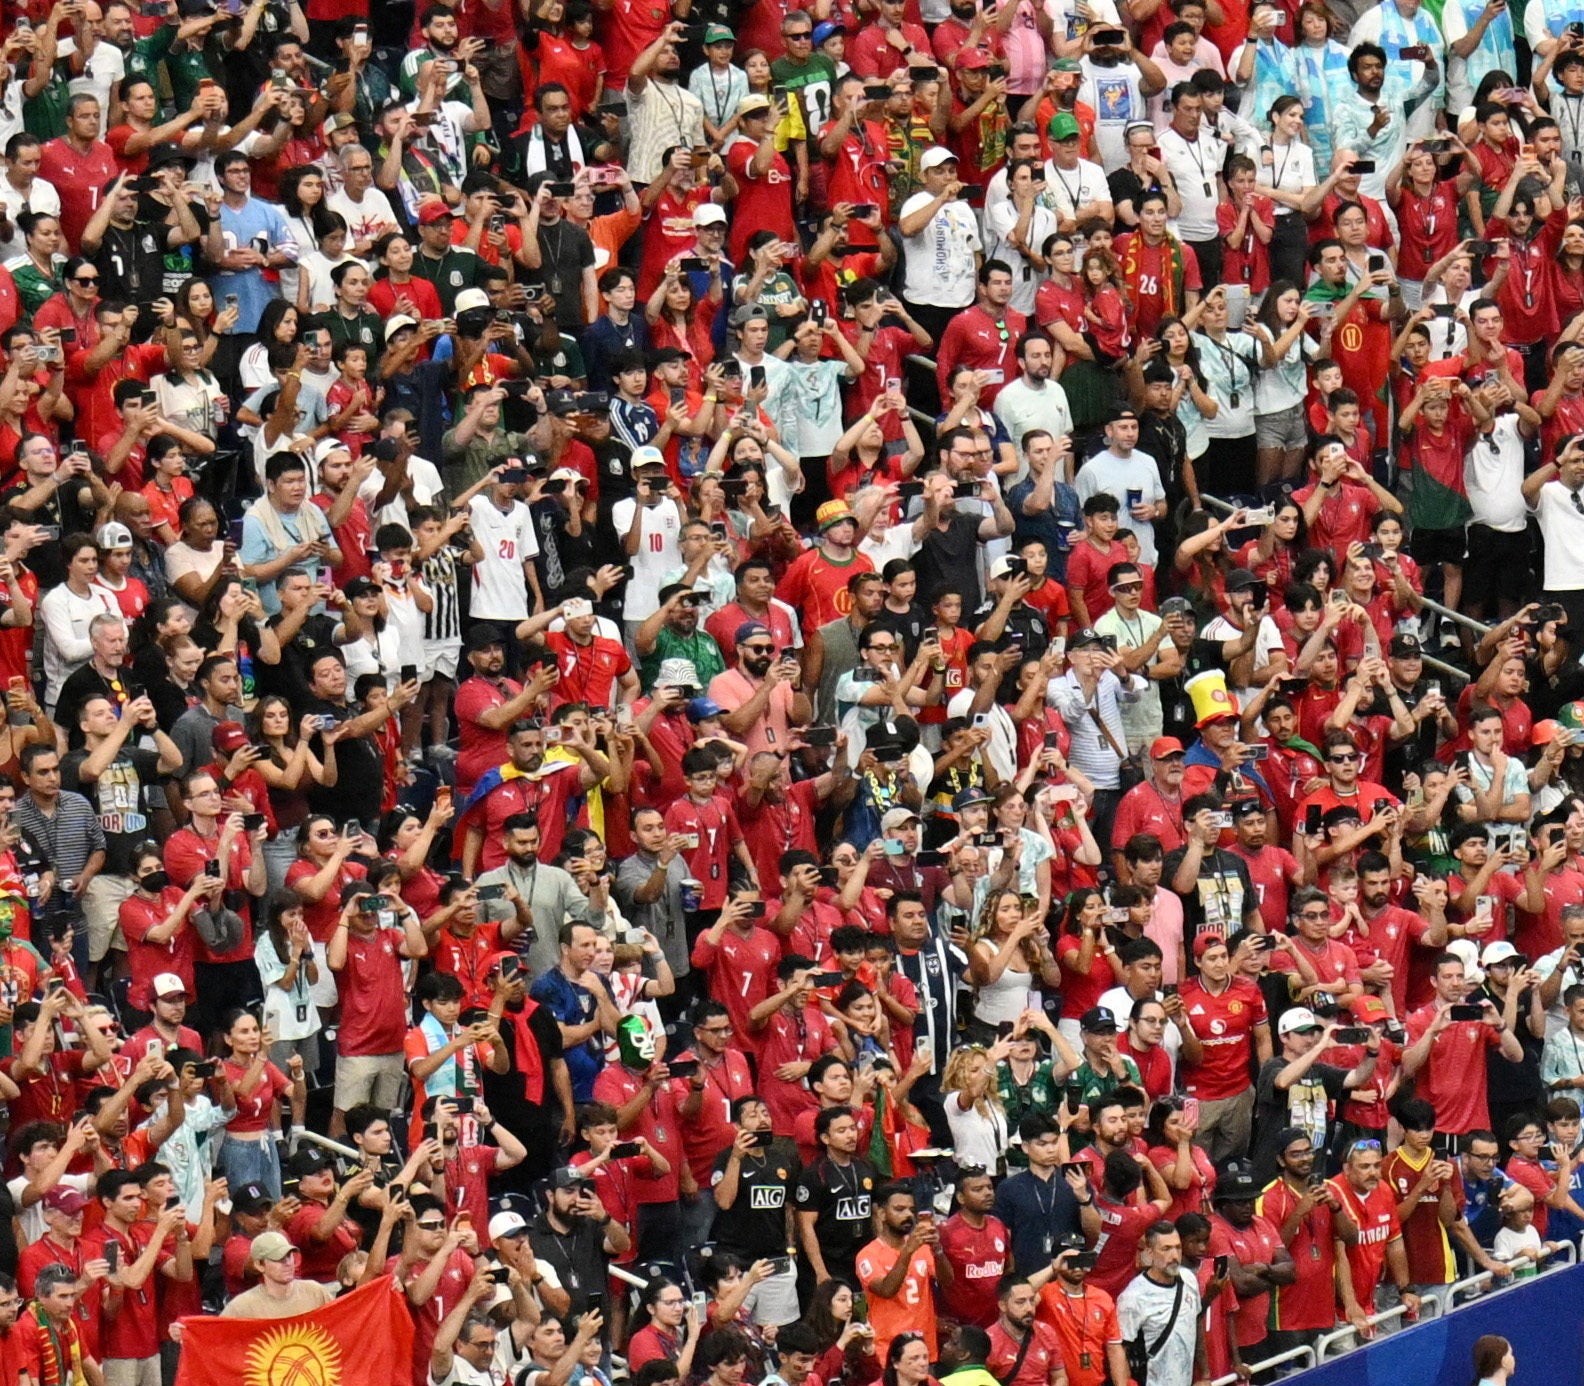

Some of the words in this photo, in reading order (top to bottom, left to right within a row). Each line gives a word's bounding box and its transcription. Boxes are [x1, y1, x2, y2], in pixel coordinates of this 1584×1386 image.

[89, 186, 99, 210] 7
[1139, 274, 1158, 295] 26
[998, 343, 1008, 365] 7
[876, 365, 886, 388] 7
[357, 533, 367, 556] 7
[499, 539, 515, 560] 20
[648, 533, 663, 553] 10
[564, 655, 577, 677] 7
[1256, 884, 1265, 904] 7
[742, 971, 753, 997] 7
[1569, 1175, 1582, 1189] 21
[755, 1188, 783, 1206] AIG
[906, 1279, 920, 1304] 2
[434, 1296, 444, 1321] 7
